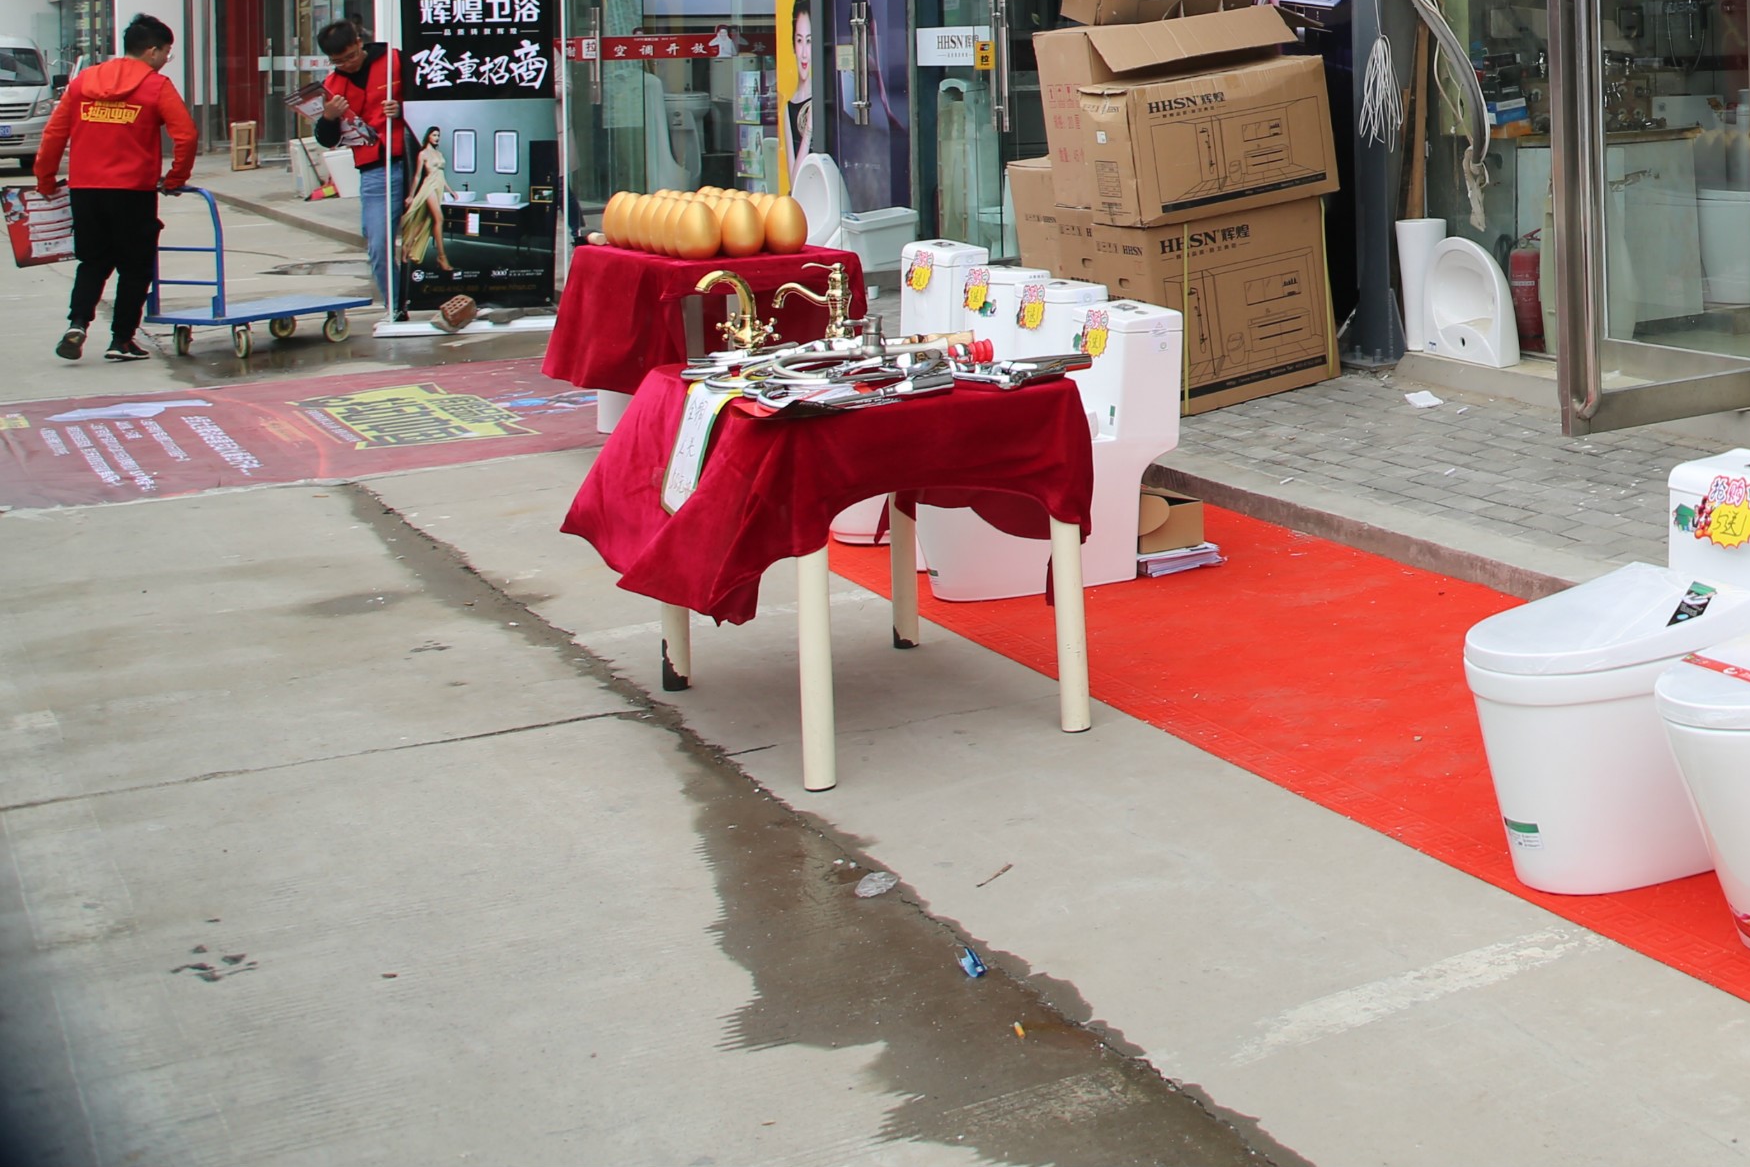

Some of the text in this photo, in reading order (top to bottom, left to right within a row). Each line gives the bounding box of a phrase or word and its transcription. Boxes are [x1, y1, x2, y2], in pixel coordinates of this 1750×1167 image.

[613, 41, 708, 57] 空调开放
[410, 39, 549, 90] 隆重招商
[1147, 96, 1198, 114] HHSN
[1200, 91, 1226, 105] 辉煌
[1221, 224, 1250, 242] 辉煌
[1122, 244, 1144, 256] HHSN
